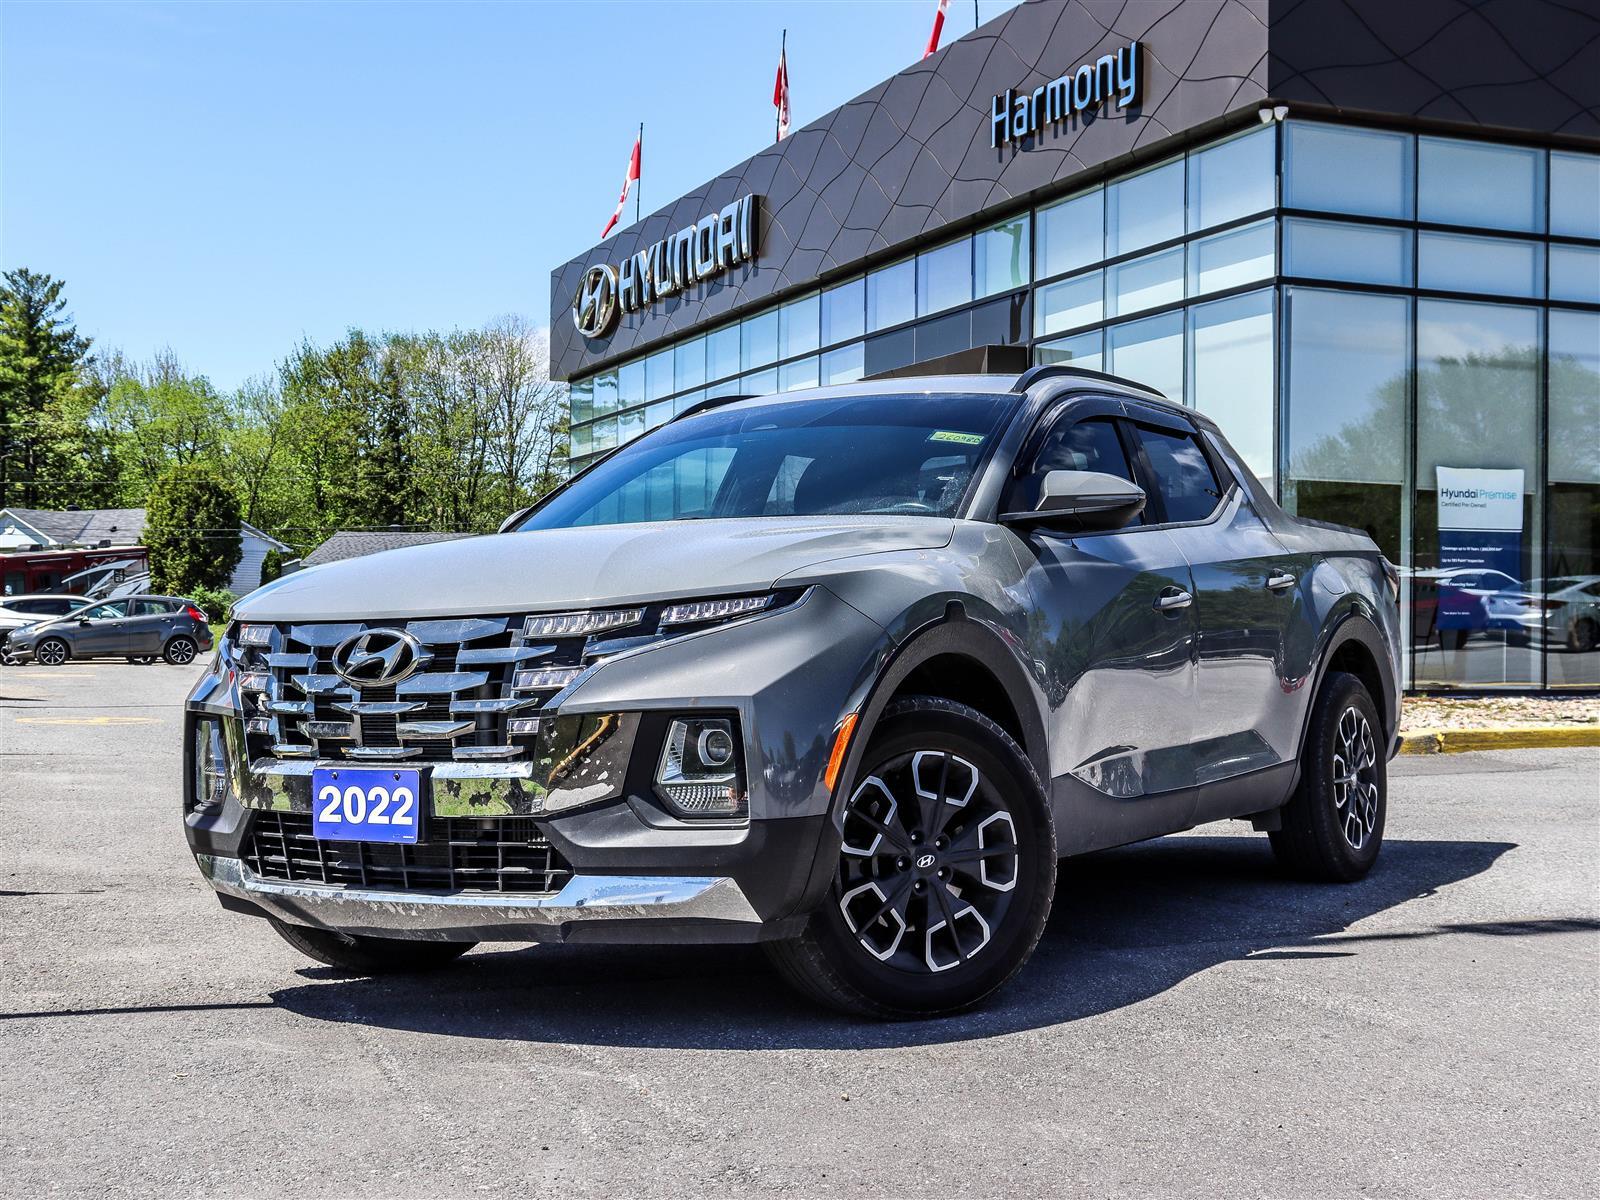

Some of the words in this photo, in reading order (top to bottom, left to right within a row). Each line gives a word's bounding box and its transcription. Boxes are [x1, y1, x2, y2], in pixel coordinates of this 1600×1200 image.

[991, 41, 1139, 149] Harmony
[618, 193, 756, 315] HYUNDAI
[1441, 488, 1479, 500] Hyundai
[1480, 490, 1518, 500] Promise
[318, 785, 414, 826] 2022
